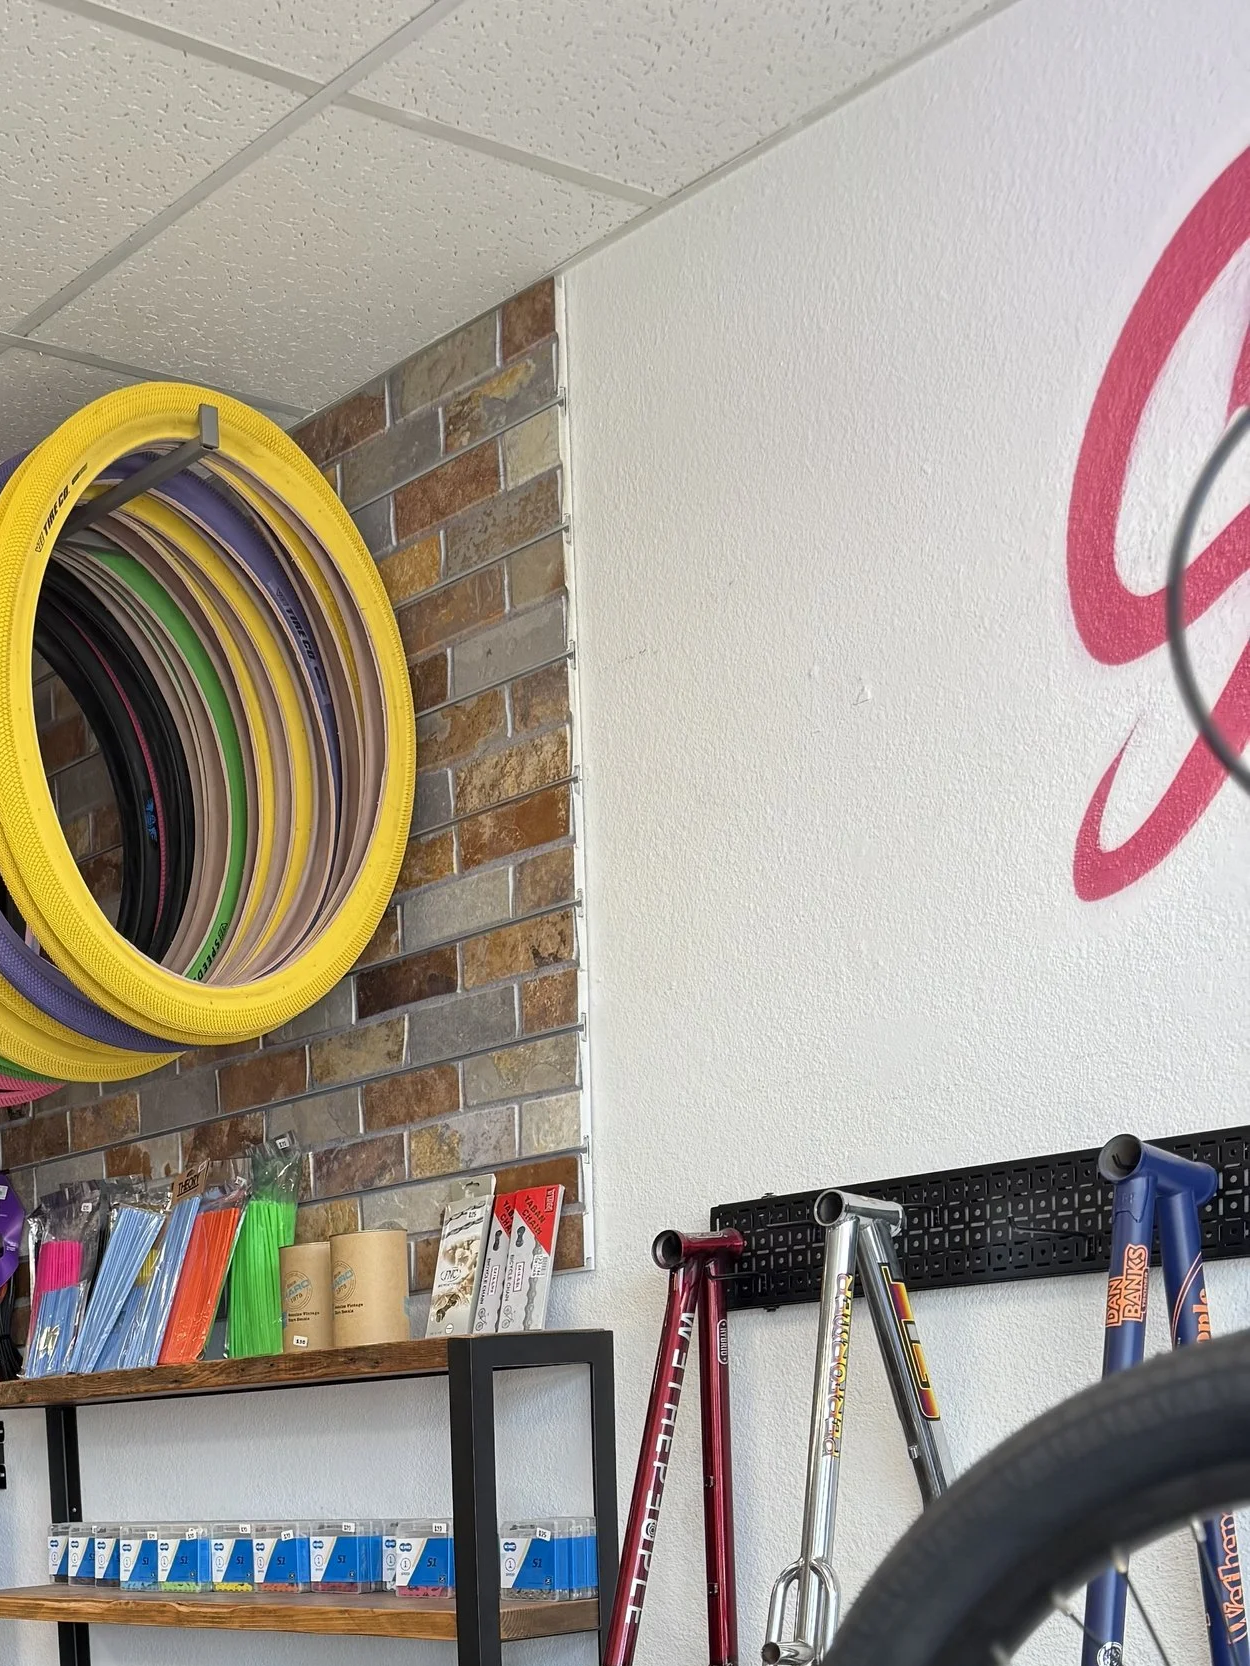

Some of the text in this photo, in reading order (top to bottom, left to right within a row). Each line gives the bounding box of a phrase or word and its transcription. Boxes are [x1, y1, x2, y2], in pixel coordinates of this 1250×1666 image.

[43, 501, 59, 536] TIRE
[285, 607, 307, 638] TIRE
[178, 1174, 200, 1191] THEORY
[1106, 1279, 1123, 1328] DAN
[1122, 1245, 1148, 1322] BANKS
[822, 1272, 855, 1458] PERFORMER
[623, 1311, 695, 1626] WETHEPEOPLE
